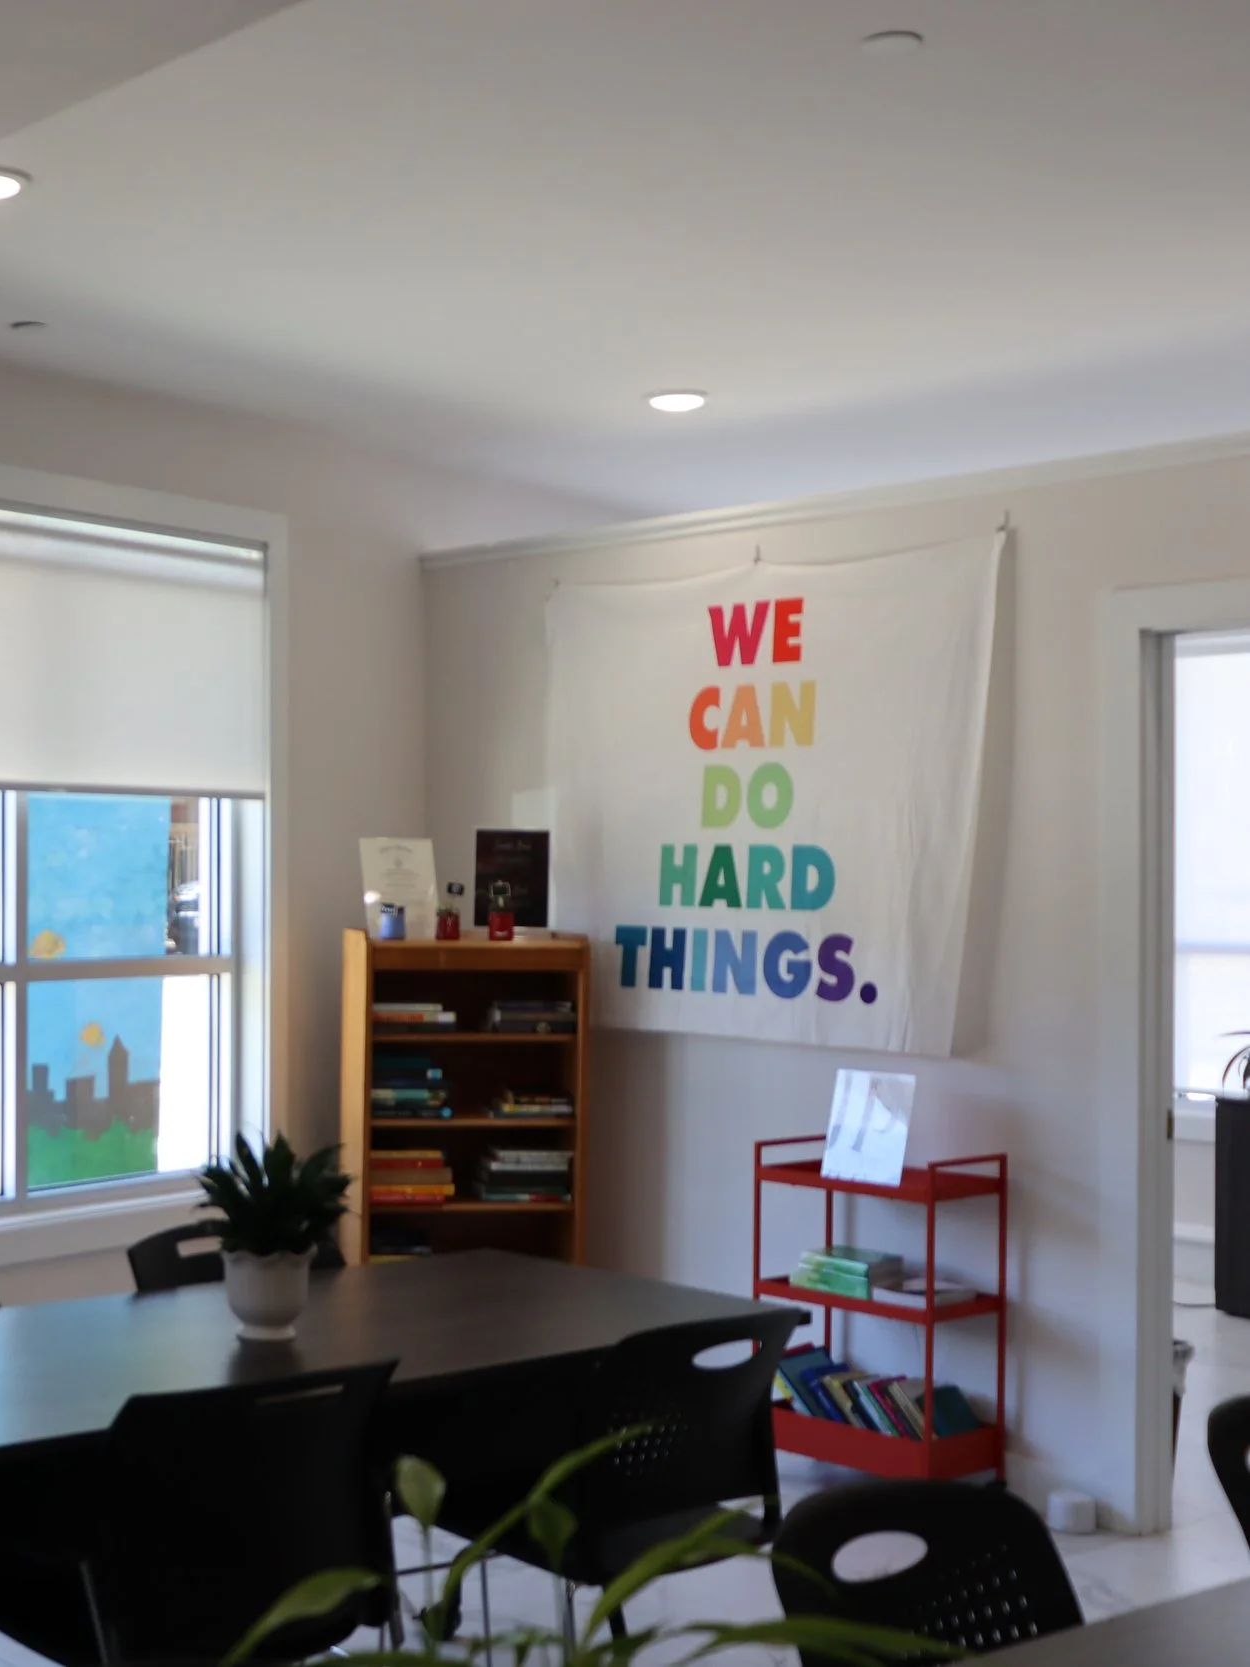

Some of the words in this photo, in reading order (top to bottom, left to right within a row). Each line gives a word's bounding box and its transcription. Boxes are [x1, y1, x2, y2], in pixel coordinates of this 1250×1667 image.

[707, 597, 805, 668] WE
[688, 680, 817, 752] CAN
[700, 761, 795, 830] DO
[658, 843, 837, 912] HARD
[615, 924, 878, 1005] THINGS.
